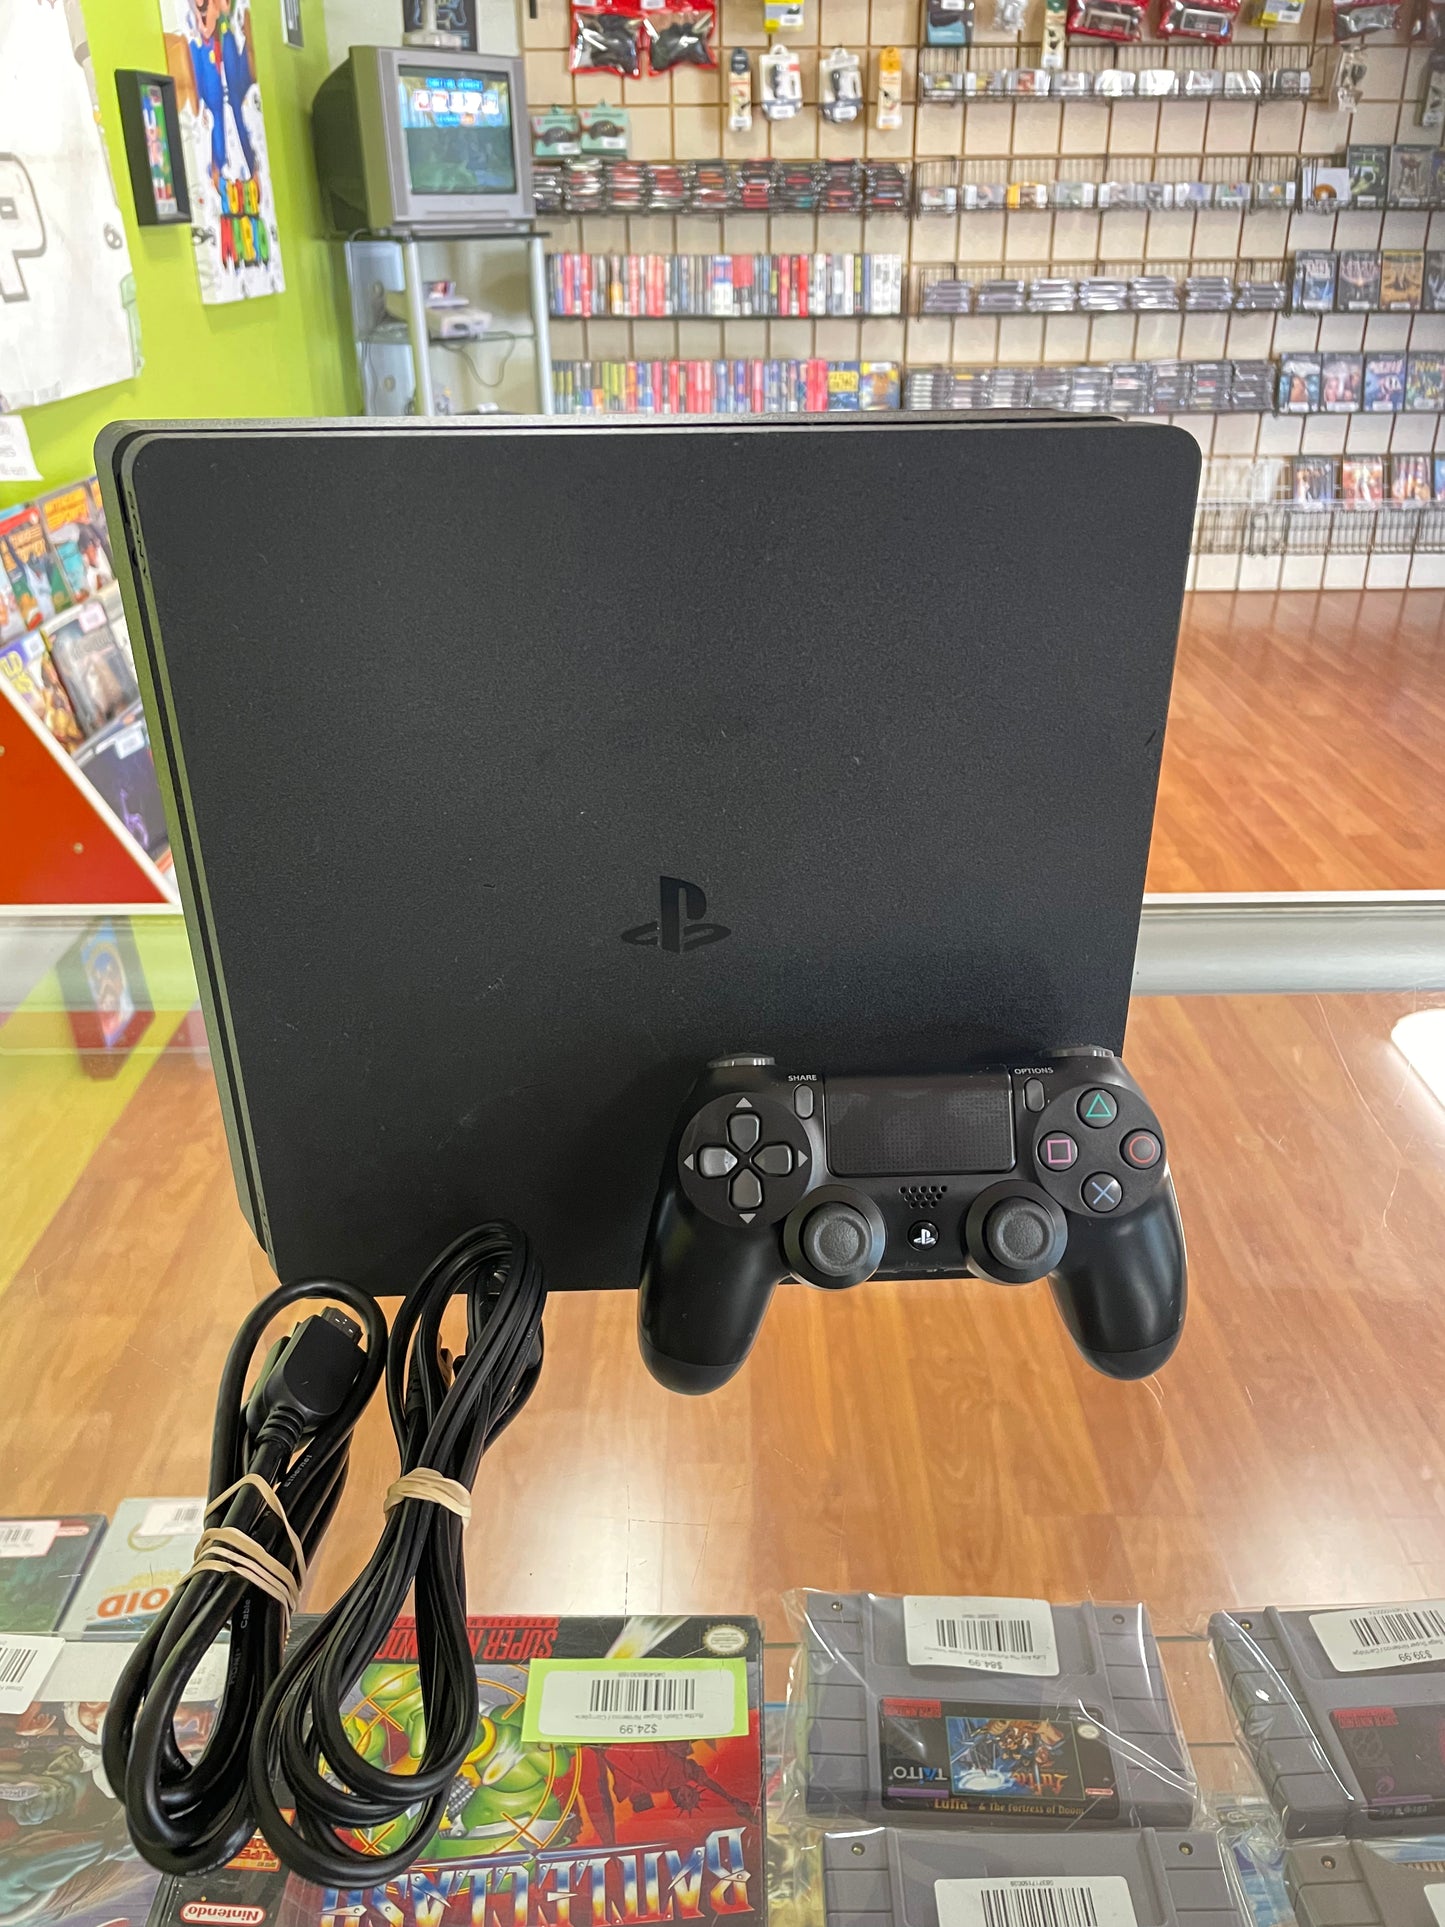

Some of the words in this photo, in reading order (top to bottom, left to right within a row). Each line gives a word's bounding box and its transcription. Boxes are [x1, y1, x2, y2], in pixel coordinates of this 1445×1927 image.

[219, 214, 270, 268] MARIO
[1014, 1067, 1054, 1075] OPTIONS
[788, 1074, 817, 1082] SHARE
[240, 1598, 252, 1630] Cable
[482, 1629, 558, 1661] SUPER
[1398, 1649, 1432, 1662] $39.99
[967, 1659, 1003, 1670] $84.99
[619, 1723, 658, 1734] $24.99
[187, 1905, 259, 1921] Nintendo
